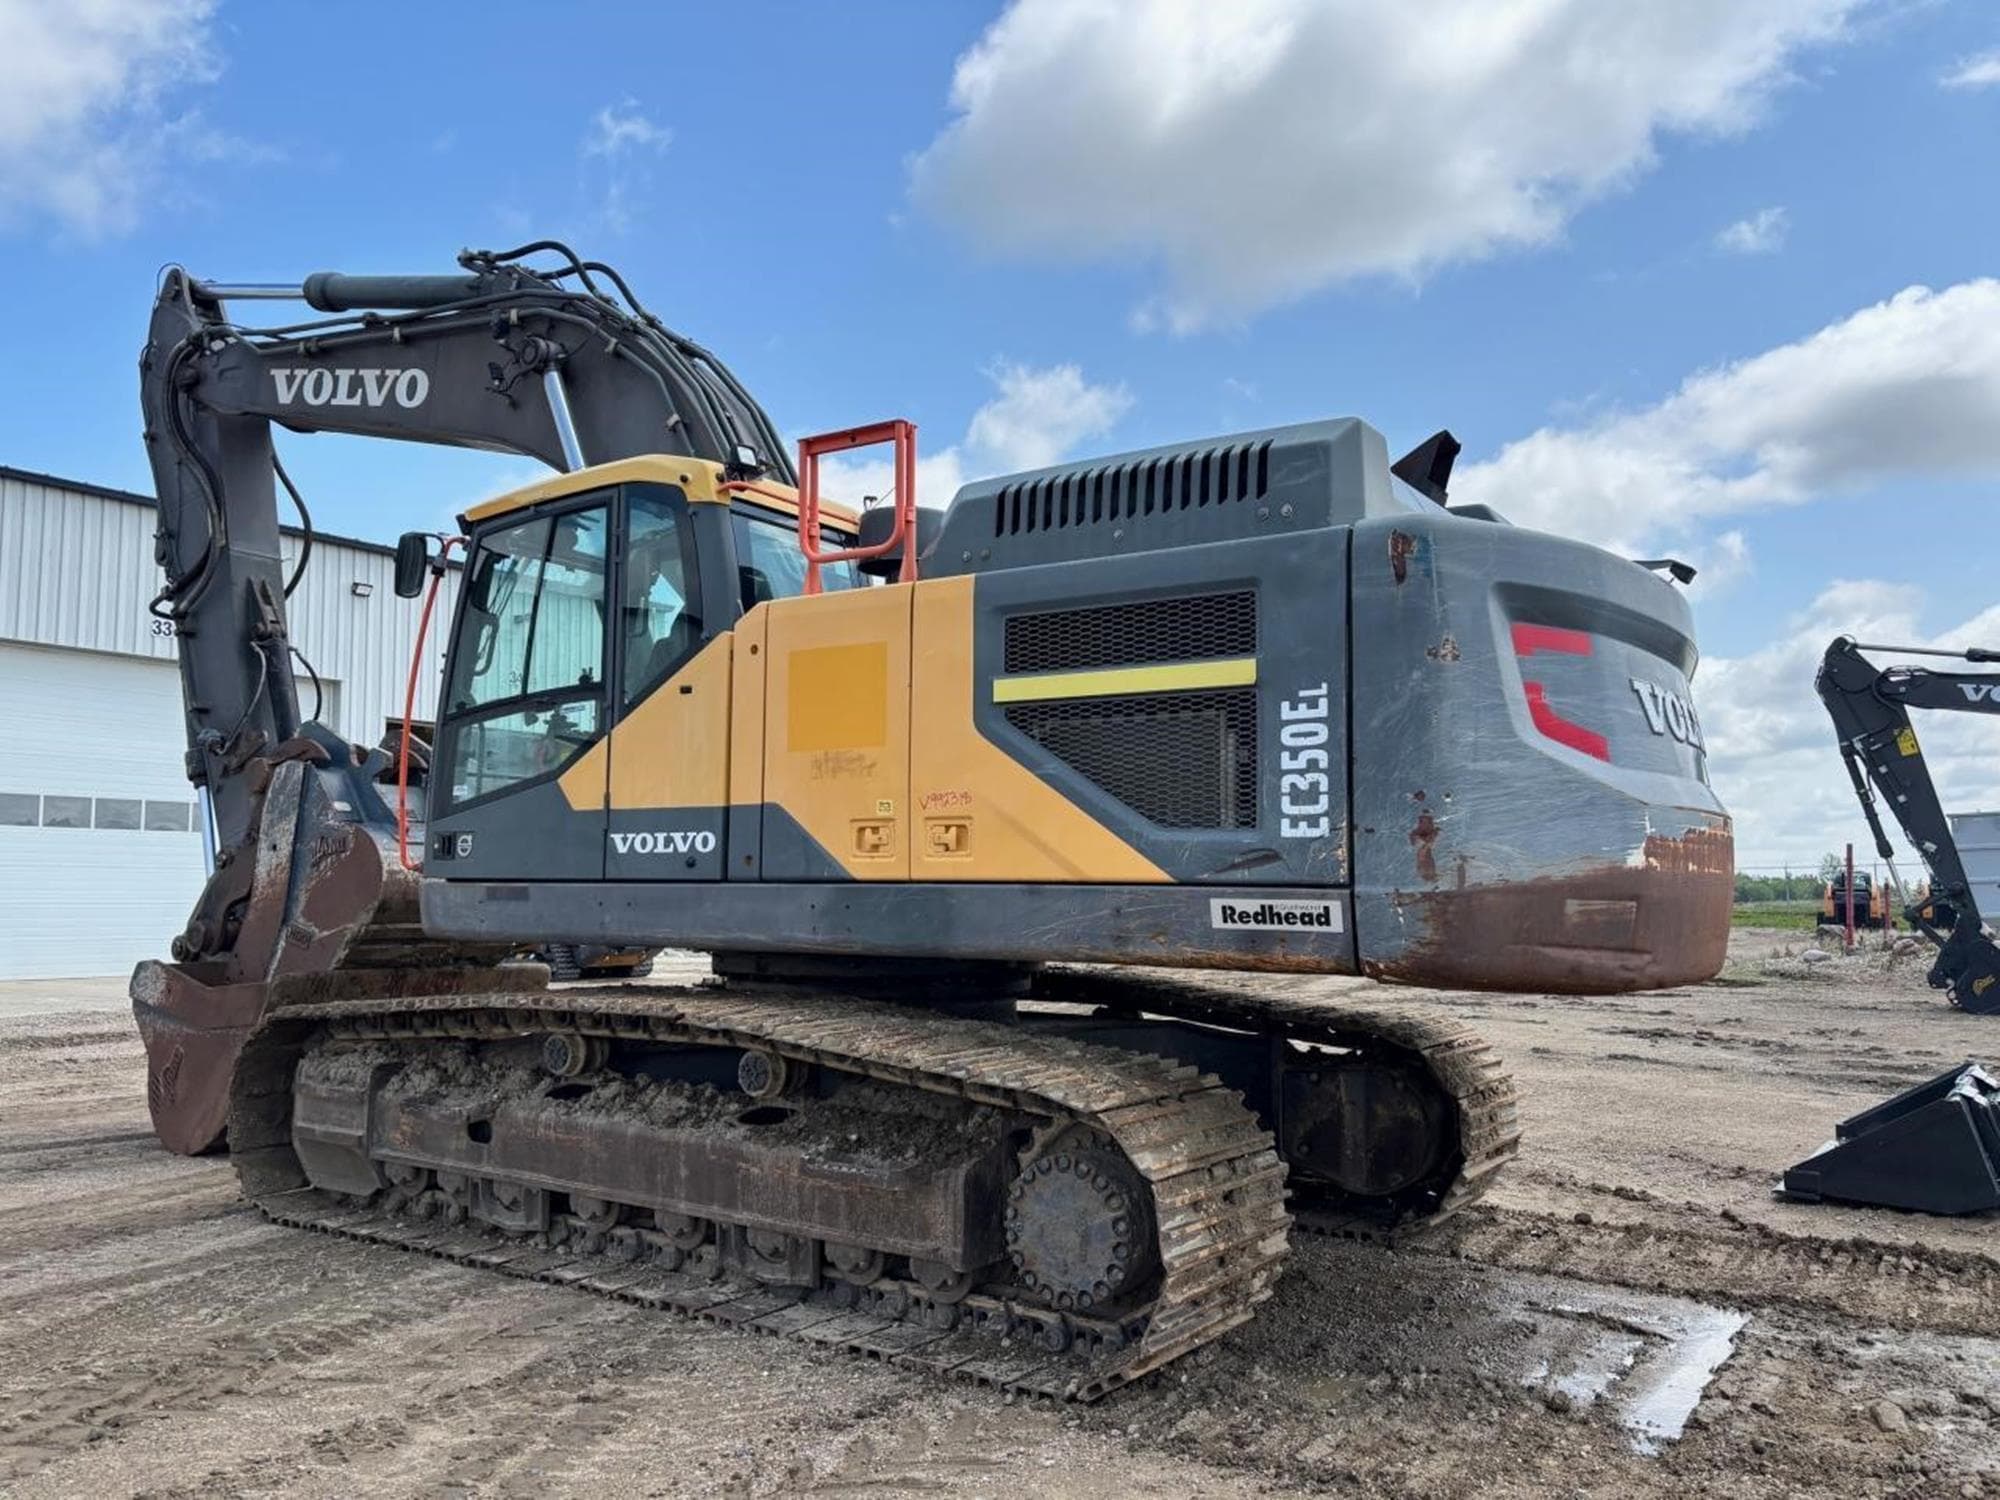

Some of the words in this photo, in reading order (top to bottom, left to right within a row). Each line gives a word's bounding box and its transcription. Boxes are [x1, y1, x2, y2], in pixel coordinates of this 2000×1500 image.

[269, 367, 430, 409] VOLVO
[1280, 682, 1329, 838] EC350EL
[610, 831, 717, 854] VOLVO
[1221, 904, 1331, 927] Redhead
